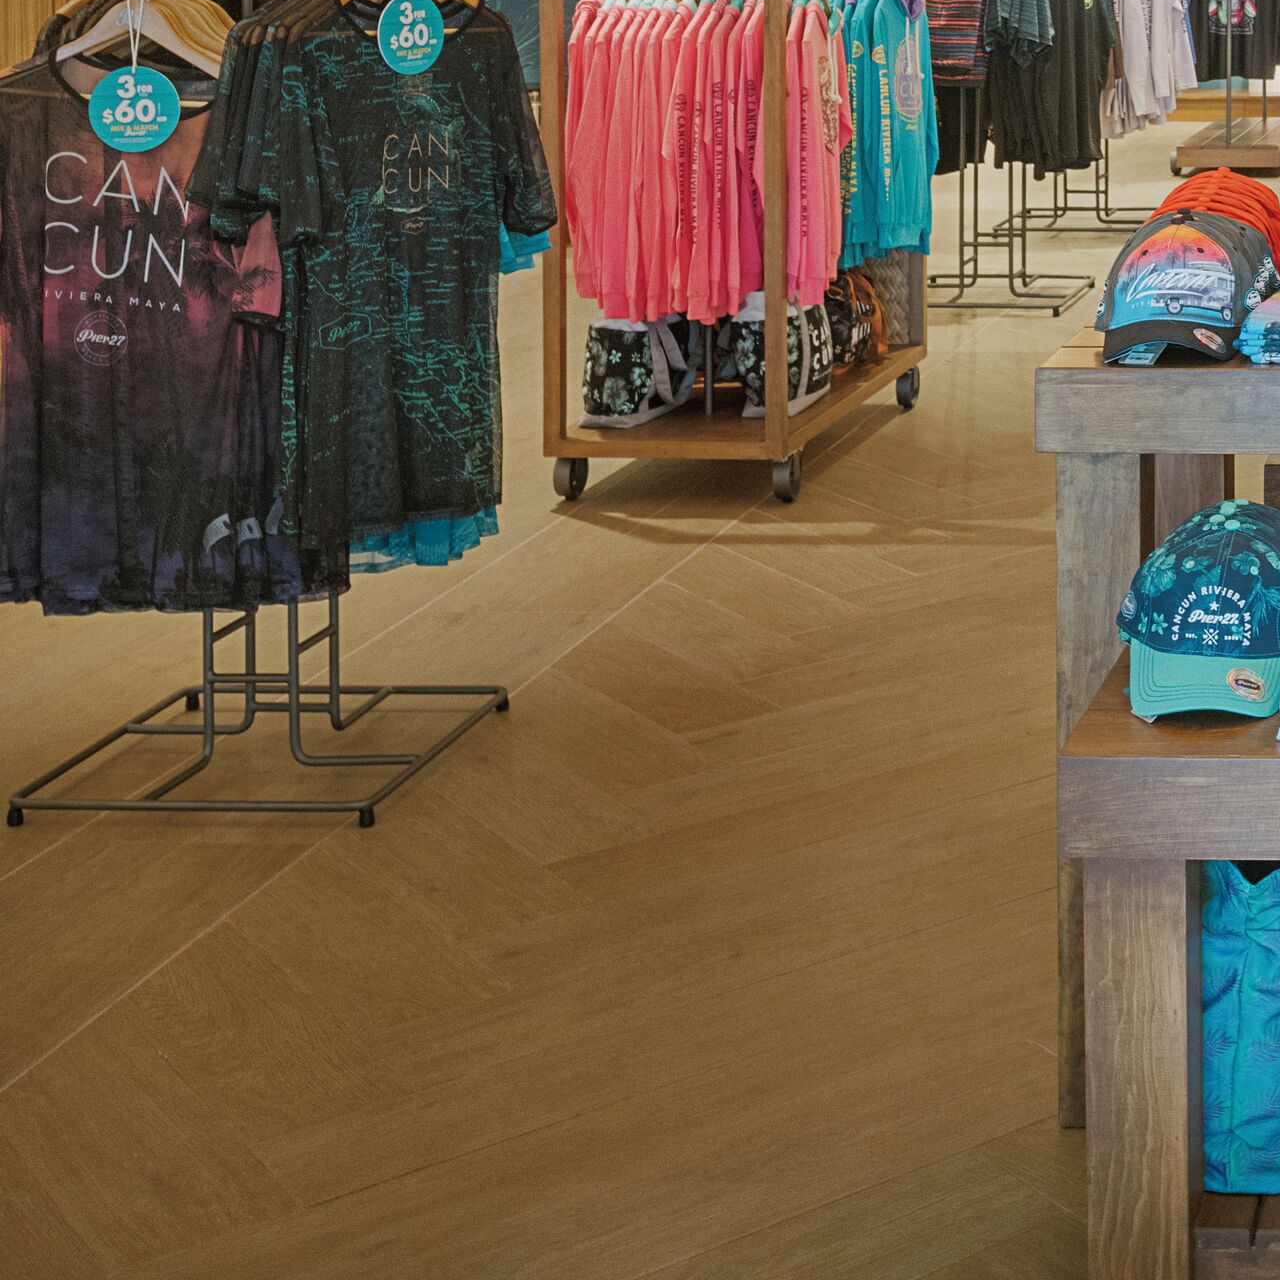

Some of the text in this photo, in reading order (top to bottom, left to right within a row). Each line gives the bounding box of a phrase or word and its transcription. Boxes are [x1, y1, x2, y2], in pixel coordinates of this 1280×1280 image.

[399, 2, 414, 25] 3
[390, 23, 429, 50] $60
[117, 74, 152, 99] 3 FOR
[102, 98, 156, 125] $60
[384, 132, 448, 160] CAN
[45, 151, 189, 222] CAN
[384, 166, 449, 194] CUN
[44, 221, 186, 288] CUN
[1126, 263, 1217, 303] Cancun
[45, 289, 181, 312] IVIERA MAYA
[76, 329, 126, 347] Pier27
[1172, 585, 1252, 646] CANCUN RIVIERA MAYA
